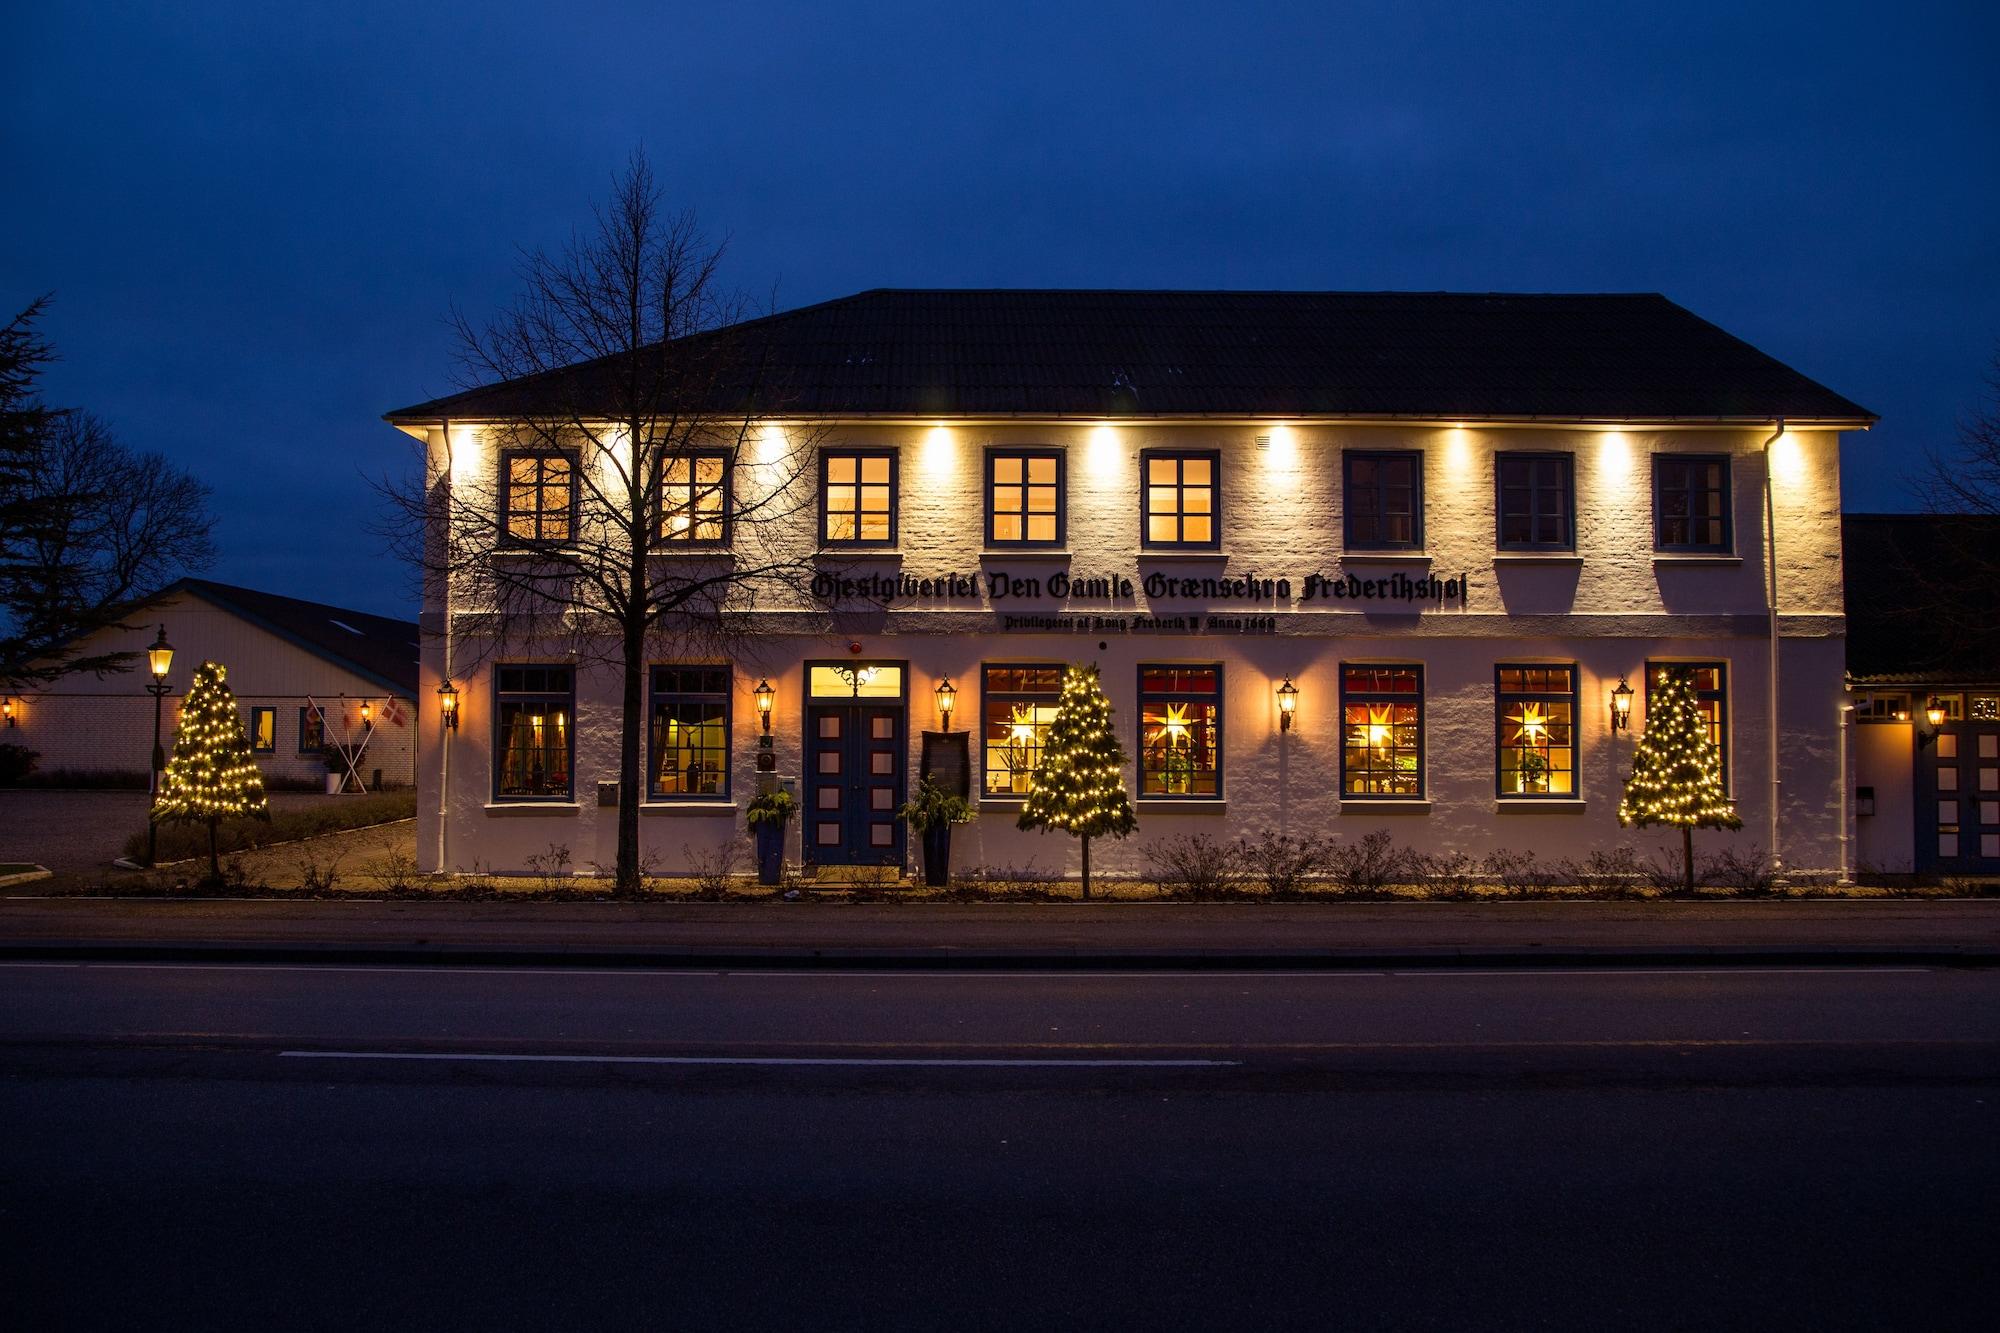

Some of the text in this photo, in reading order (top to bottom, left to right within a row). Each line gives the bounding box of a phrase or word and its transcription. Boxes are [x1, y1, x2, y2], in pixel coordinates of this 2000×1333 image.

[988, 571, 1041, 598] Den
[1048, 571, 1134, 598] Gamle
[1144, 571, 1291, 602] Grænsekro
[1297, 571, 1467, 604] Frederikshøj
[1077, 615, 1090, 629] af
[1095, 615, 1126, 631] Kong
[1130, 615, 1186, 631] Frederik
[1207, 615, 1242, 629] Anno
